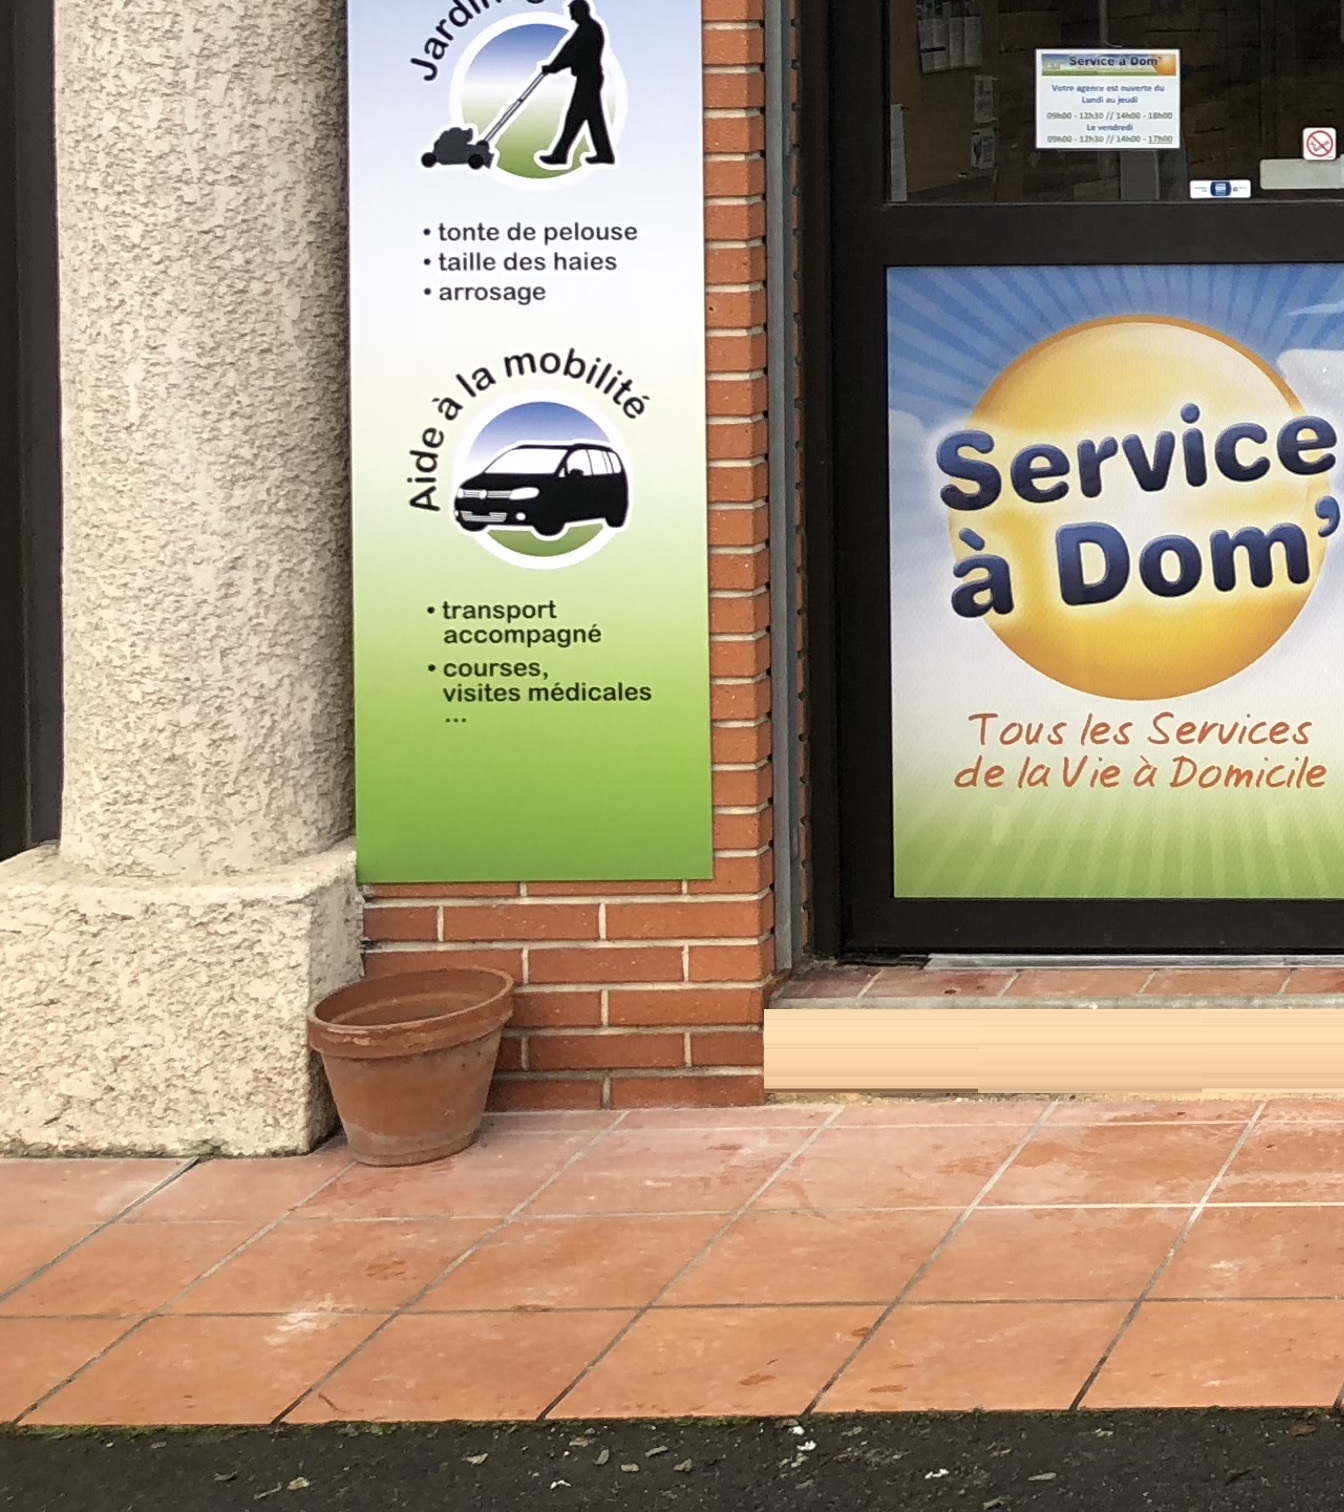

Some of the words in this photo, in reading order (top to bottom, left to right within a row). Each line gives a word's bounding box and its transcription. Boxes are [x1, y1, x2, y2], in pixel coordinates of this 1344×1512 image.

[1069, 56, 1115, 66] Service
[1130, 56, 1162, 66] Dom'
[438, 222, 500, 241] tonte
[507, 222, 536, 241] de
[543, 222, 639, 245] pelouse
[438, 252, 497, 271] taille
[503, 252, 546, 271] des
[553, 252, 618, 271] haies
[438, 284, 547, 305] arrosage
[407, 426, 445, 512] Aide
[431, 397, 464, 421] à
[455, 365, 497, 398] la
[503, 347, 652, 420] mobilité
[935, 402, 1338, 511] Service
[950, 527, 1015, 618] à
[1055, 495, 1341, 607] Dom'
[442, 600, 558, 622] transport
[443, 623, 602, 648] accompagné
[443, 660, 549, 681] courses,
[443, 683, 521, 702] visites
[528, 682, 652, 702] médicales
[968, 713, 1067, 746] Tous
[1080, 712, 1131, 746] les
[1147, 712, 1313, 746] Services
[953, 756, 1005, 788] de
[1017, 755, 1050, 788] la
[1062, 755, 1121, 789] Vie
[1133, 754, 1158, 788] à
[1170, 755, 1327, 789] Domicile
